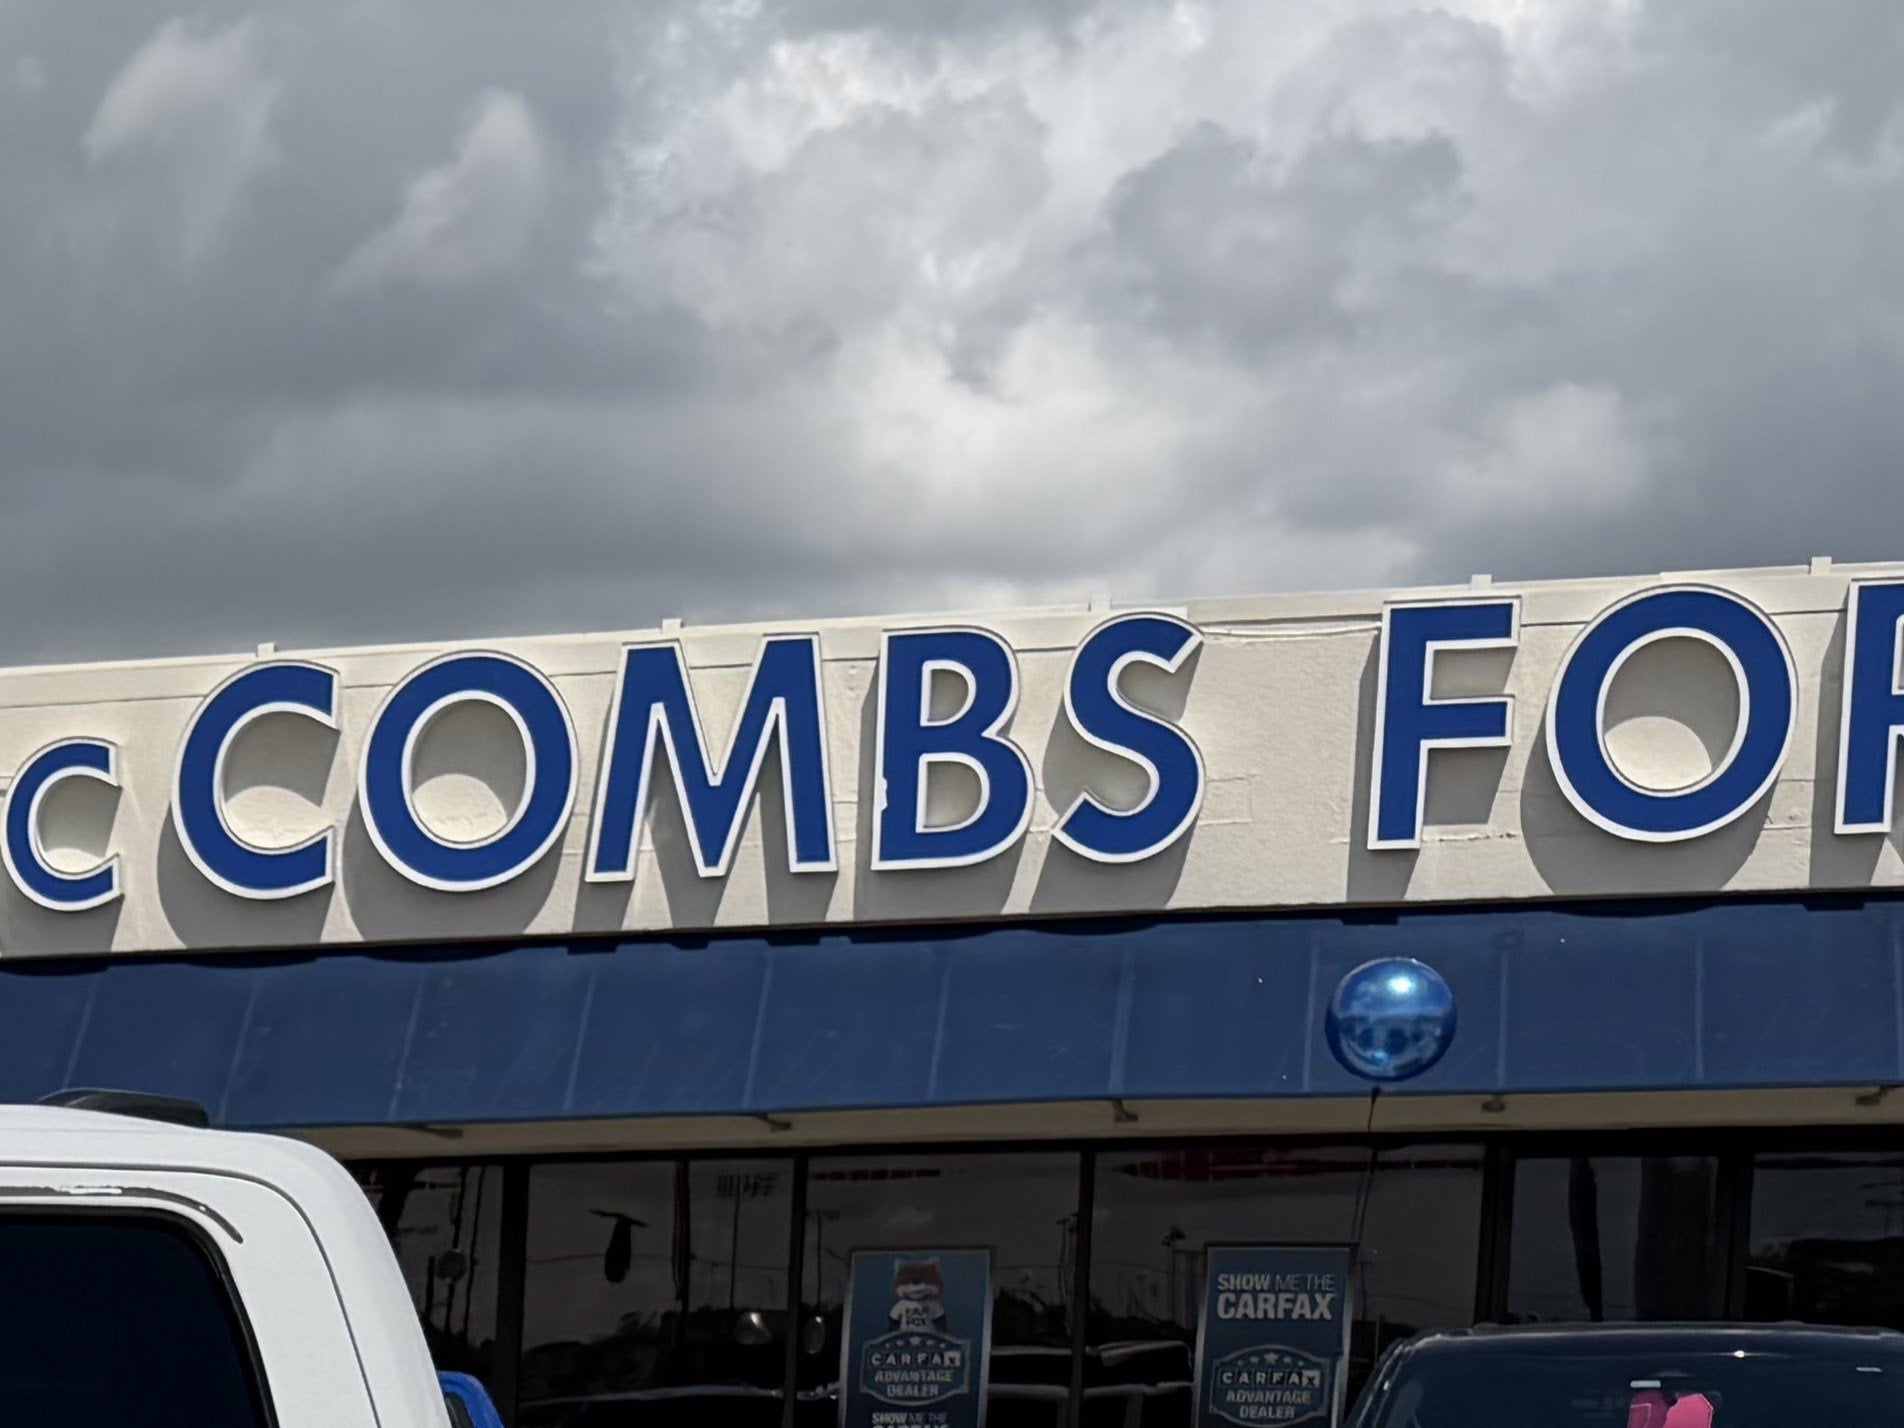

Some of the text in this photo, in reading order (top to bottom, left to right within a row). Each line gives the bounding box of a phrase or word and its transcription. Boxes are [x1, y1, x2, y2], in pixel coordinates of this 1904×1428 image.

[1217, 1272, 1337, 1291] SHOW ME THE
[1217, 1292, 1337, 1320] CARFAX
[1222, 1369, 1321, 1387] CARFAX
[1226, 1389, 1312, 1404] ADVANTAGE
[1239, 1405, 1295, 1419] DEALER
